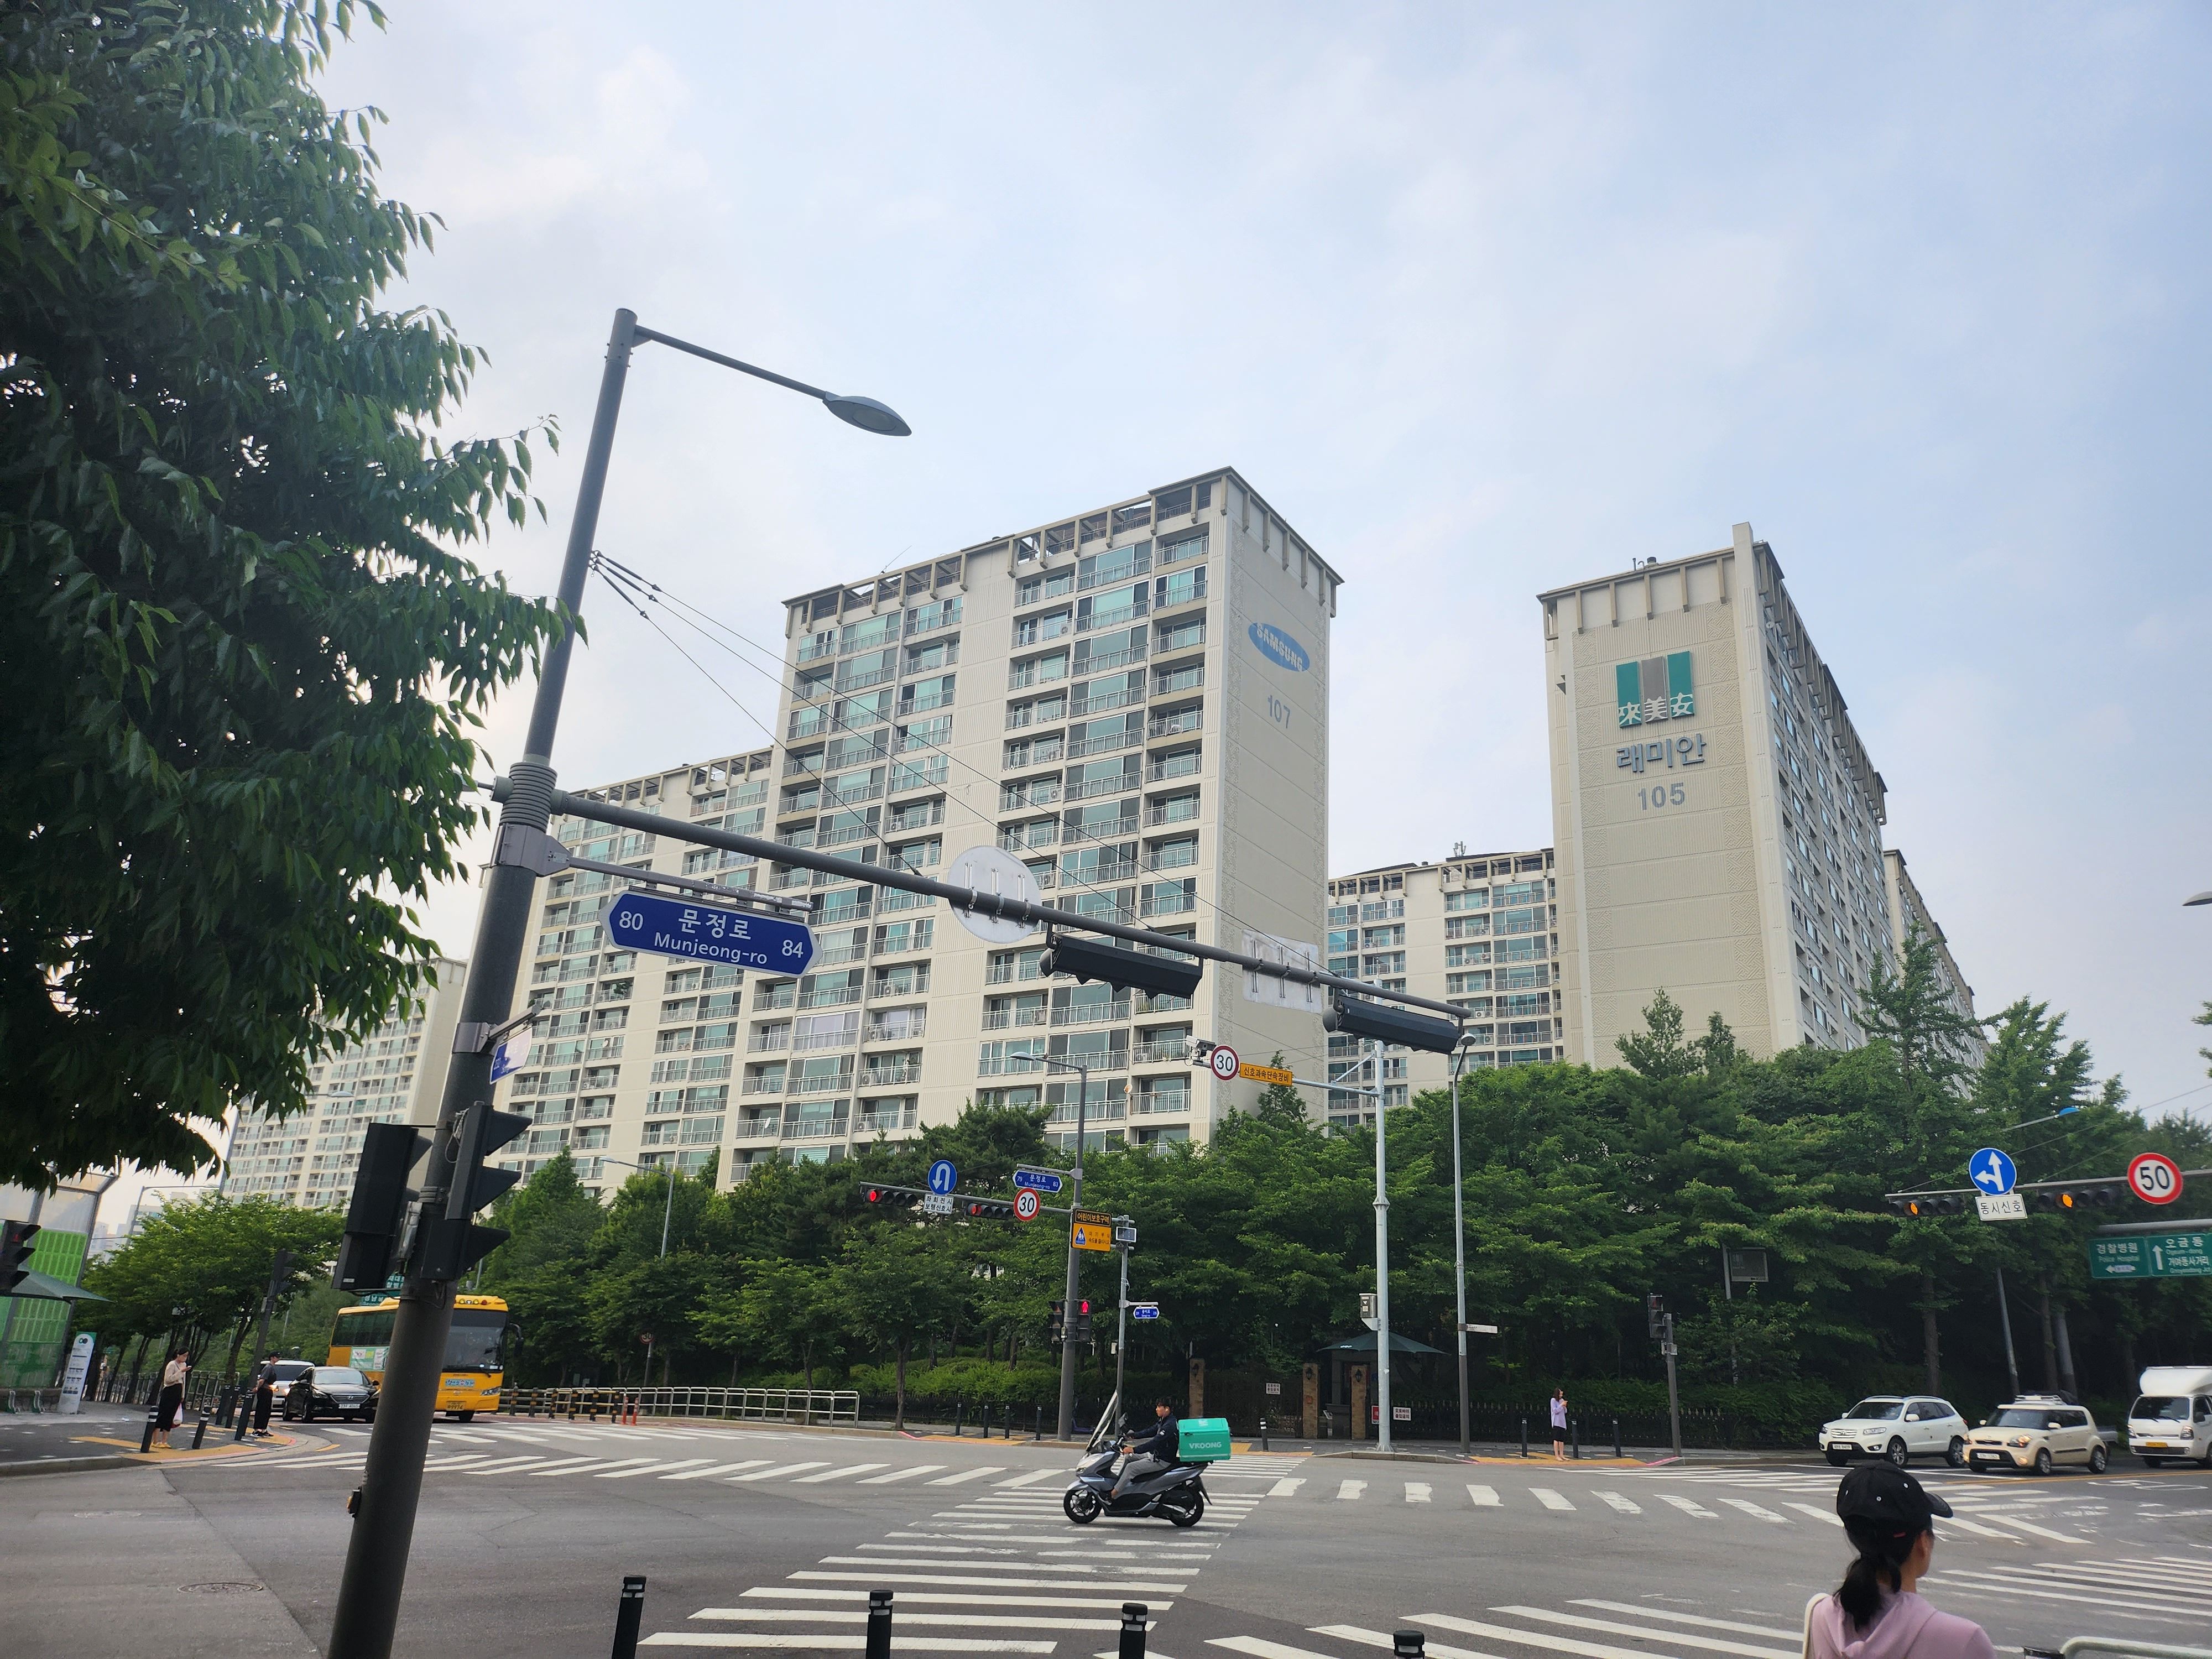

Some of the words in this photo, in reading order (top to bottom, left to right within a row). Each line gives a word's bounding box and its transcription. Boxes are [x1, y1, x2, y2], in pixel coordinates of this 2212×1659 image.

[1256, 622, 1302, 672] SAMSUNG
[1267, 695, 1291, 729] 107
[1616, 733, 1707, 773] 래미안
[1638, 782, 1685, 811] 105
[619, 911, 644, 931] 80
[678, 909, 752, 940] 문정로
[654, 932, 767, 964] Munjeong-ro
[781, 940, 804, 959] 84
[1217, 1054, 1233, 1072] 30
[1244, 1066, 1289, 1082] 신호과속단속장비
[1030, 1174, 1046, 1183] 문정로
[2140, 1165, 2171, 1191] 50
[925, 1203, 951, 1212] 보행신호시
[1019, 1196, 1035, 1212] 30
[1980, 1199, 2022, 1215] 동시신호
[1077, 1213, 1109, 1224] 어린이보호구역
[2096, 1243, 2138, 1254] 경찰병원
[2165, 1237, 2204, 1248] 오금동
